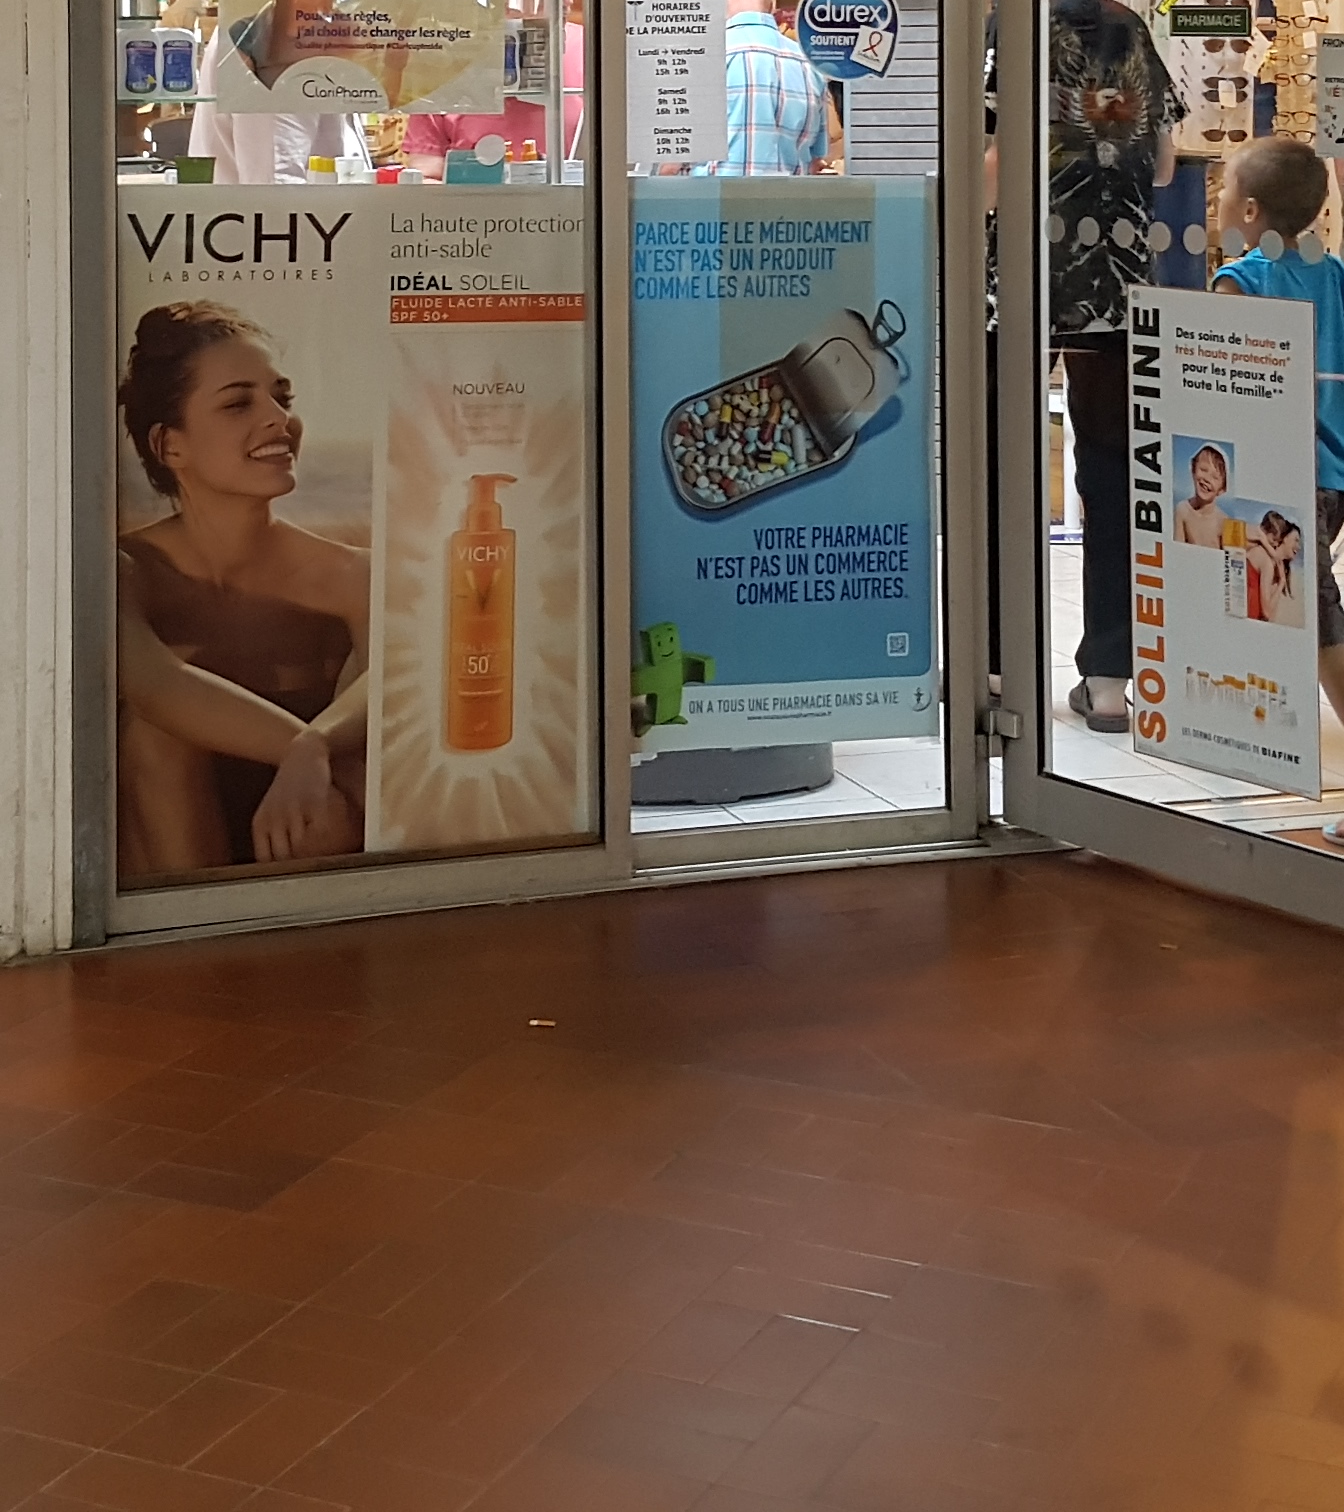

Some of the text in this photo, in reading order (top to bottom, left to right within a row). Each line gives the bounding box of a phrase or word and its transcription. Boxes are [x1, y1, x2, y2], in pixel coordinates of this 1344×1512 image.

[652, 2, 701, 11] HORAIRES
[295, 10, 325, 22] Pou
[353, 10, 392, 25] règles,
[645, 14, 710, 23] D'OUVERTURE
[1177, 14, 1242, 28] PHARMACIE
[317, 26, 351, 38] choisi
[353, 26, 368, 38] de
[369, 26, 417, 41] changer
[419, 26, 435, 38] les
[436, 26, 471, 41] règles
[637, 26, 649, 35] LA
[651, 25, 707, 35] PHARMACIE
[810, 35, 856, 46] SOUTIENT
[638, 48, 705, 56] Lundi Vendredi
[672, 58, 687, 66] 12h
[655, 68, 670, 76] 15h
[302, 79, 378, 98] ClariPharm
[658, 88, 687, 96] Samedi
[653, 127, 692, 135] Dimanche
[389, 213, 415, 234] La
[420, 213, 478, 234] haute
[636, 216, 873, 245] PARCE QUE LE MÉDICAMENT
[127, 212, 354, 265] VICHY
[389, 238, 493, 260] anti-sable
[635, 247, 837, 273] N'EST PAS UN PRODUIT
[148, 268, 335, 283] LABORATOIRES
[390, 270, 530, 292] IDÉAL SOLEIL
[635, 274, 811, 300] COMME LES AUTRES
[392, 294, 584, 309] FLUIDE LACTÉ ANTI-SABLE
[392, 311, 450, 322] SPF 50+
[1175, 327, 1291, 351] Des soins de haute et
[1174, 344, 1195, 356] très
[1197, 345, 1228, 360] haute
[1182, 362, 1284, 384] pour les peaux de
[452, 383, 526, 395] NOUVEAU
[1182, 377, 1212, 391] toute
[1215, 379, 1227, 393] la
[1132, 306, 1167, 743] SOLEIL BIAFINE
[753, 523, 909, 551] VOTRE PHARMACIE
[456, 545, 511, 563] VICHY
[697, 550, 909, 580] N'EST PAS UN COMMERCE
[737, 577, 909, 605] COMME LES AUTRES.
[688, 690, 900, 714] ON A TOUS UNE PHARMACIE DANS SA VIE
[1261, 746, 1302, 765] BIAFINE
